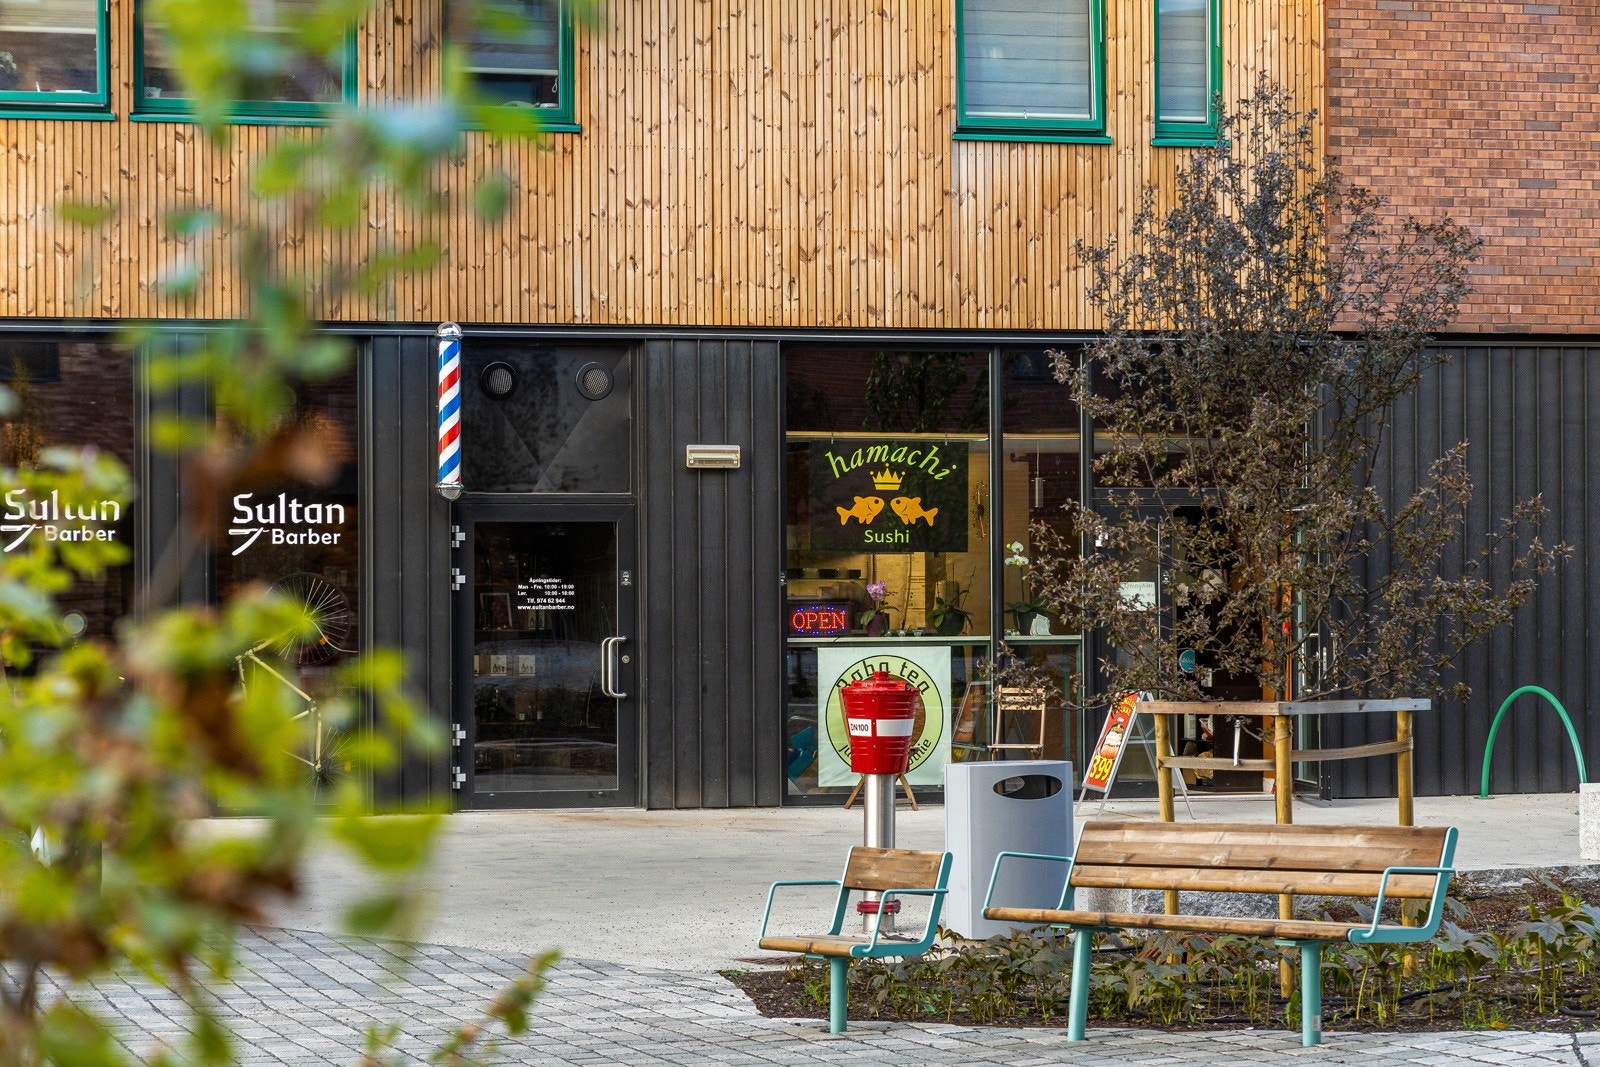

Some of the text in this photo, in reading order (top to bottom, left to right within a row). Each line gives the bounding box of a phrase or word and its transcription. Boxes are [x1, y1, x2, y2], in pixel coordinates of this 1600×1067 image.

[825, 444, 957, 480] hamachi
[232, 492, 345, 525] Sultan
[44, 525, 116, 542] Barber
[271, 528, 341, 545] Barber
[864, 529, 910, 544] Sushi
[793, 612, 846, 629] OPEN
[850, 723, 869, 732] DN100
